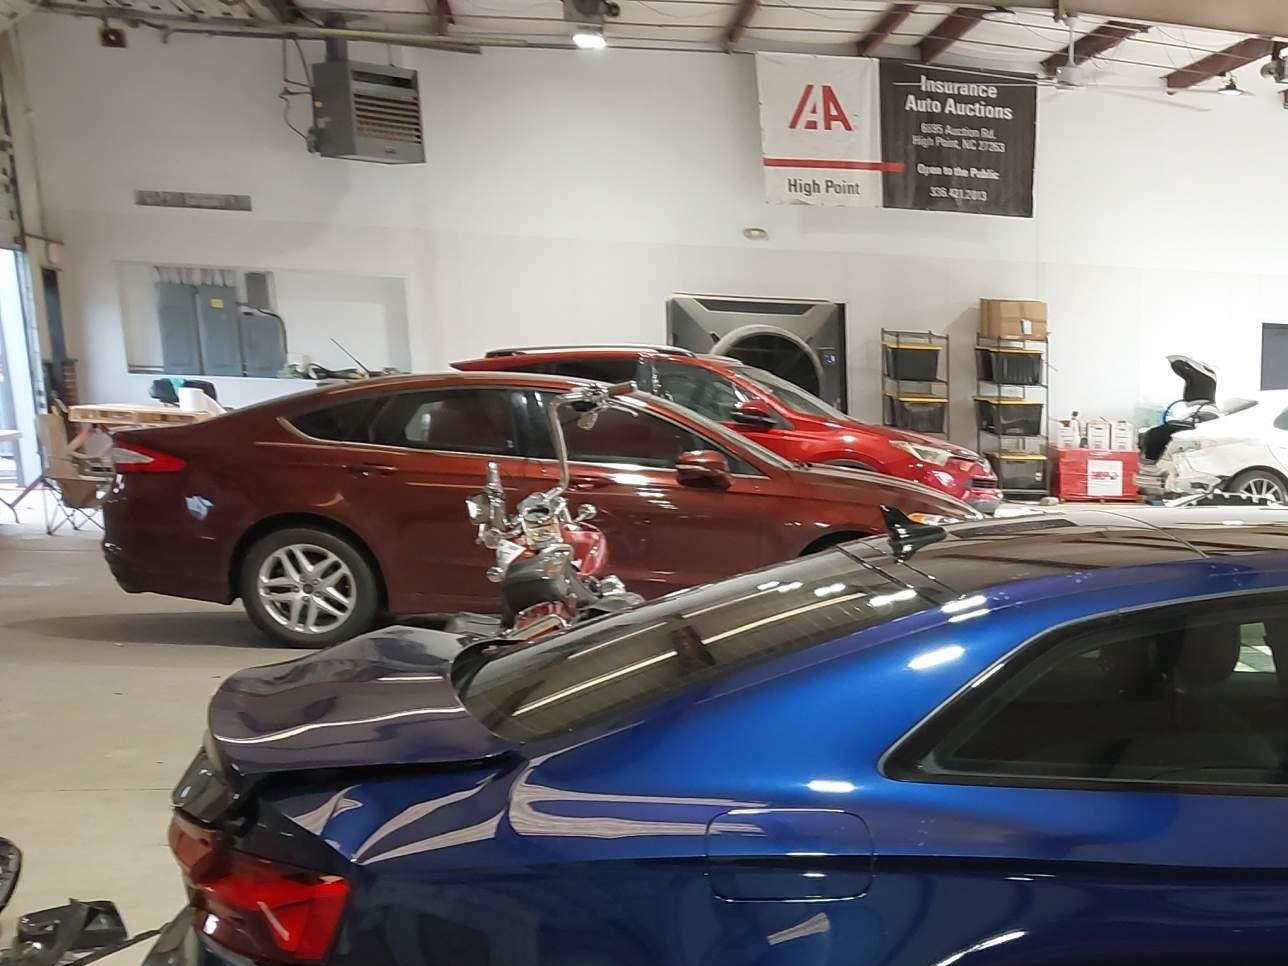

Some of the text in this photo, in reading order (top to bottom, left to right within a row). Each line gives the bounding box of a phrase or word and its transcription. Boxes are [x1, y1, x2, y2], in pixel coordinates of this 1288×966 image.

[920, 75, 998, 98] Insurance
[905, 94, 1013, 119] Auto Auctions
[945, 125, 980, 138] Auction
[912, 134, 935, 148] High
[962, 139, 977, 151] NC
[917, 163, 1000, 180] Open to the Public
[787, 178, 861, 197] High Point
